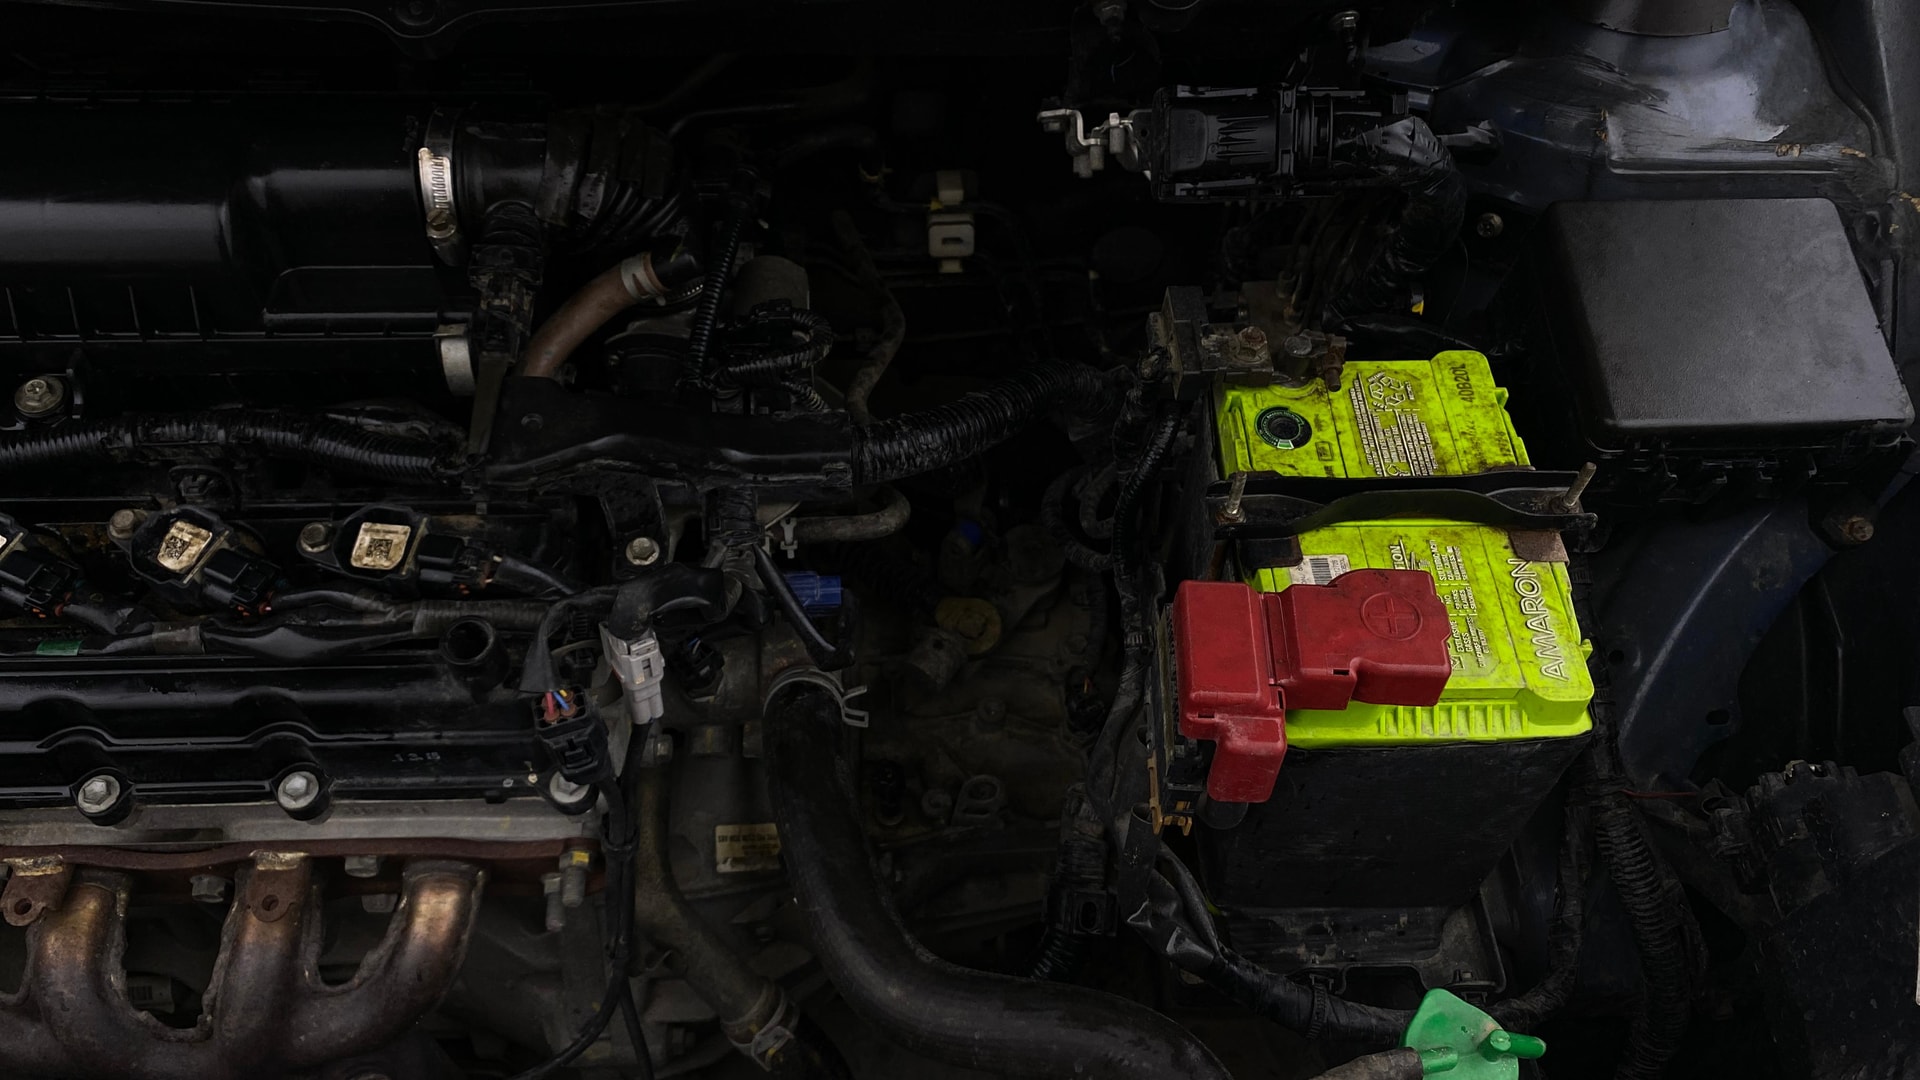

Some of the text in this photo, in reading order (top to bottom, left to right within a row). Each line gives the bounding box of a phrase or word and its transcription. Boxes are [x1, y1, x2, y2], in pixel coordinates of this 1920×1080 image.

[1451, 363, 1475, 403] 40B20L
[1389, 545, 1405, 570] TION
[1444, 595, 1452, 604] NO
[1508, 558, 1569, 682] AMARON
[1462, 632, 1474, 652] GASES
